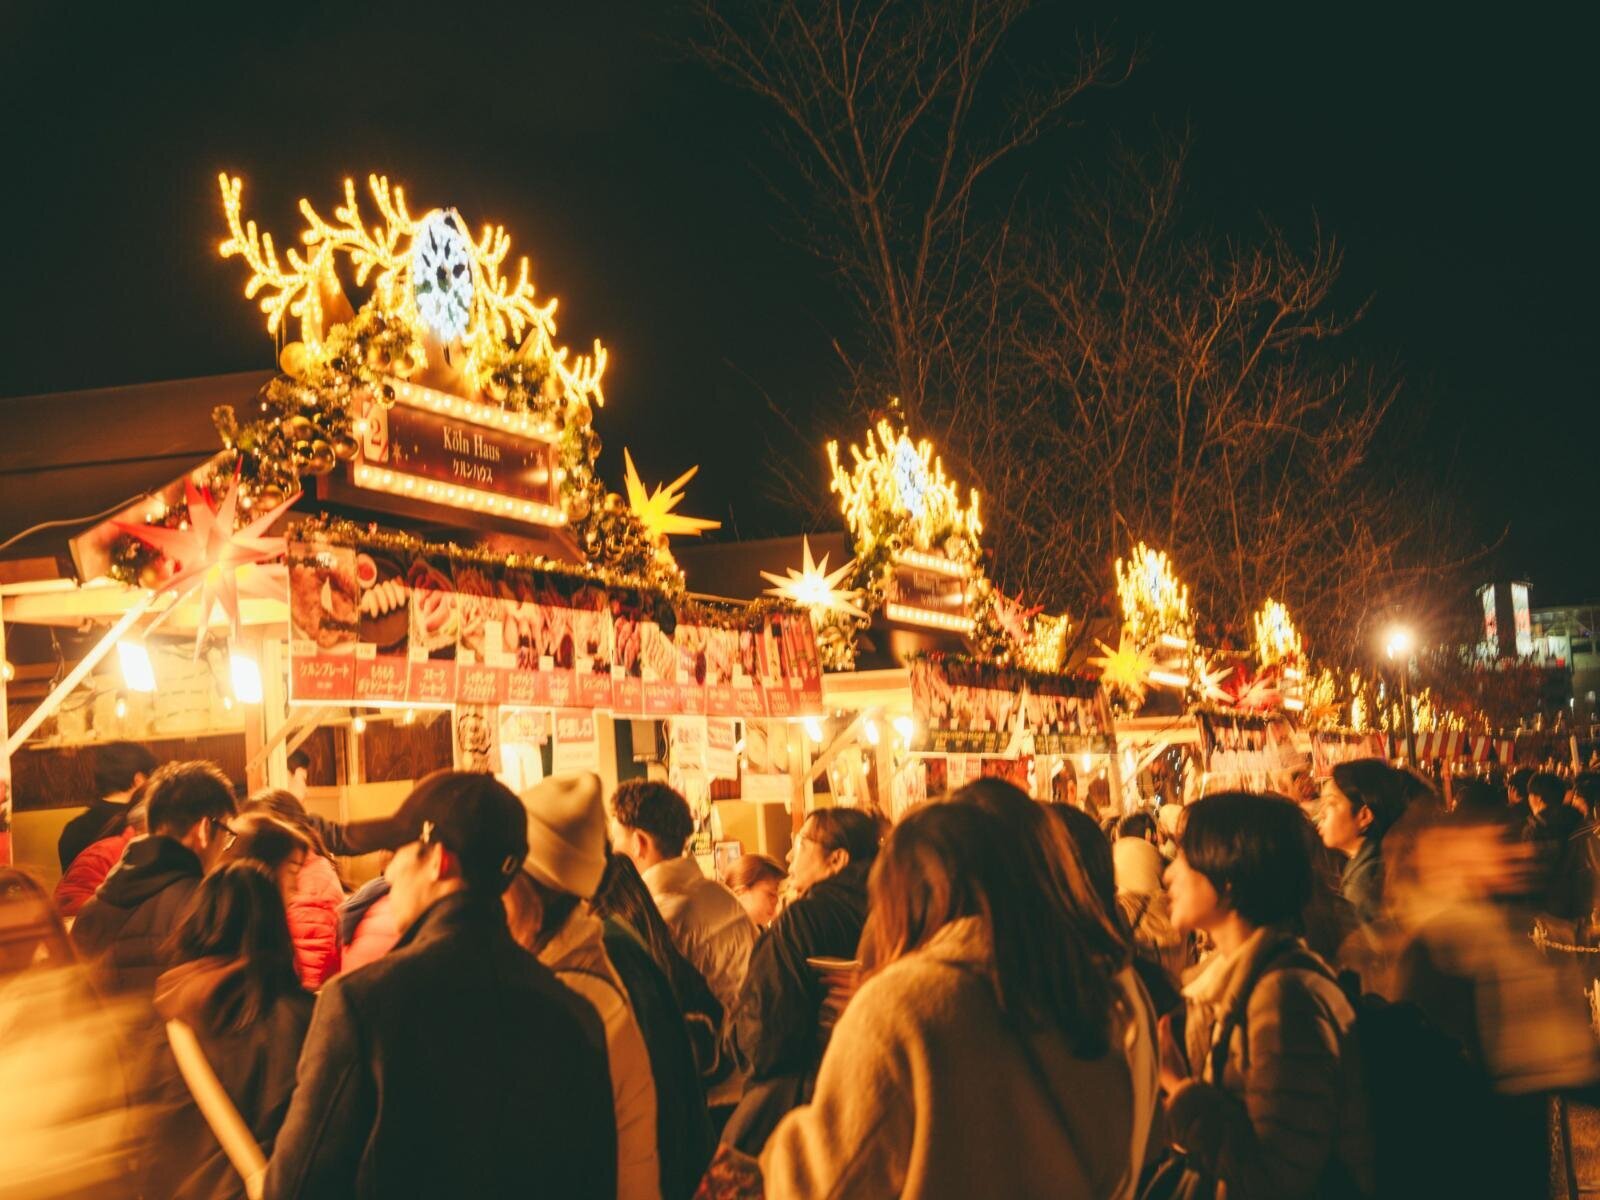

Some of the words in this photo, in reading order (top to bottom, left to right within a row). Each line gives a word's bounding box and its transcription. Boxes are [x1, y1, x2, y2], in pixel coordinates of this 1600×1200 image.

[443, 425, 470, 455] Köln
[474, 434, 500, 462] Haus
[453, 459, 493, 485] ケルンハウス
